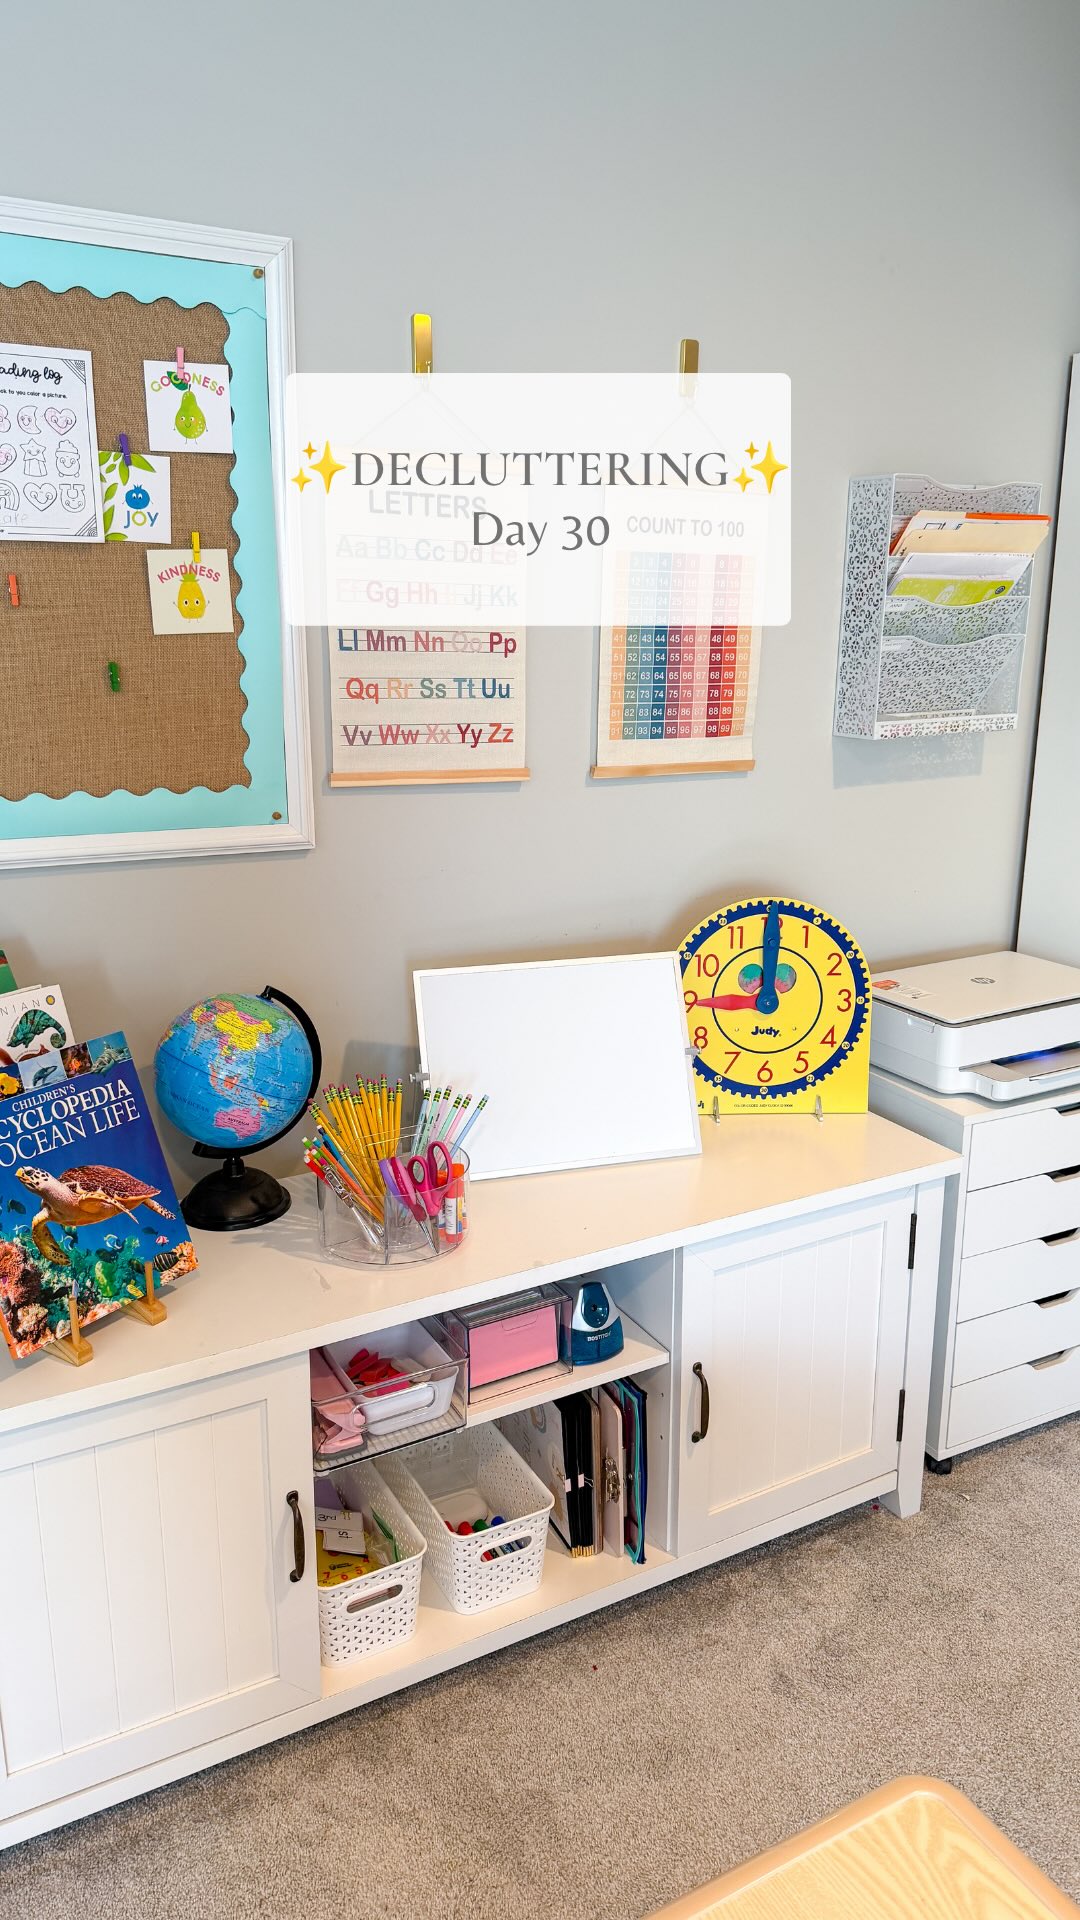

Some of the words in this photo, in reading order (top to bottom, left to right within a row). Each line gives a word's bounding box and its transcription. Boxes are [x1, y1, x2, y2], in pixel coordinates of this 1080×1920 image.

[43, 366, 63, 385] log
[368, 489, 487, 520] LETTERS
[124, 510, 159, 529] JOY
[627, 516, 686, 535] COUNT
[690, 520, 712, 536] TO
[717, 521, 745, 537] 100
[336, 535, 368, 559] Aa
[377, 536, 407, 560] Bb
[415, 539, 446, 562] Cc
[453, 540, 482, 563] Dd
[157, 564, 221, 584] KINDNESS
[366, 580, 399, 608] Gg
[407, 582, 438, 604] Hh
[464, 584, 482, 610] Jj
[490, 584, 518, 607] Kk
[366, 629, 407, 651] Mm
[414, 630, 445, 652] Nn
[451, 630, 483, 653] Oo
[489, 632, 517, 658] Pp
[628, 635, 638, 643] 42
[642, 635, 652, 643] 43
[655, 635, 665, 643] 44
[670, 635, 680, 643] 45
[684, 635, 693, 643] 46
[712, 635, 721, 643] 48
[726, 635, 735, 643] 49
[627, 653, 637, 661] 52
[642, 653, 652, 661] 53
[655, 653, 665, 661] 54
[670, 653, 680, 661] 55
[683, 653, 693, 661] 56
[711, 653, 721, 661] 58
[725, 653, 734, 661] 59
[626, 672, 637, 680] 62
[641, 672, 650, 680] 63
[669, 671, 679, 679] 65
[683, 671, 692, 679] 66
[710, 671, 720, 679] 68
[724, 671, 734, 679] 69
[346, 677, 379, 704] Qq
[387, 678, 413, 699] Rr
[420, 677, 447, 699] Ss
[453, 678, 476, 699] Tt
[482, 678, 510, 699] Uu
[626, 690, 635, 698] 72
[640, 690, 650, 698] 73
[654, 690, 664, 698] 74
[682, 689, 692, 697] 76
[709, 689, 719, 697] 78
[723, 689, 733, 697] 79
[625, 708, 635, 716] 82
[639, 708, 649, 716] 83
[652, 708, 662, 716] 84
[681, 707, 691, 715] 86
[708, 707, 718, 715] 88
[343, 725, 372, 746] Vv
[379, 724, 419, 745] Ww
[425, 724, 451, 744] Xx
[456, 723, 483, 748] Yy
[488, 723, 514, 743] Zz
[624, 726, 633, 734] 92
[638, 726, 647, 734] 93
[652, 726, 662, 734] 94
[666, 726, 677, 734] 95
[707, 725, 717, 733] 98
[720, 725, 730, 733] 99
[727, 926, 744, 949] 11
[802, 925, 809, 948] 1
[695, 954, 719, 977] 10
[827, 953, 842, 976] 2
[684, 990, 698, 1013] 9
[837, 989, 852, 1012] 3
[694, 1026, 708, 1049] 8
[751, 1026, 777, 1037] Judy
[820, 1025, 837, 1048] 4
[725, 1052, 741, 1074] 7
[757, 1060, 773, 1083] 6
[793, 1051, 809, 1074] 5
[12, 1084, 76, 1112] CHILDREN'S
[0, 1116, 87, 1167] OCEAN
[89, 1098, 141, 1134] LIFE
